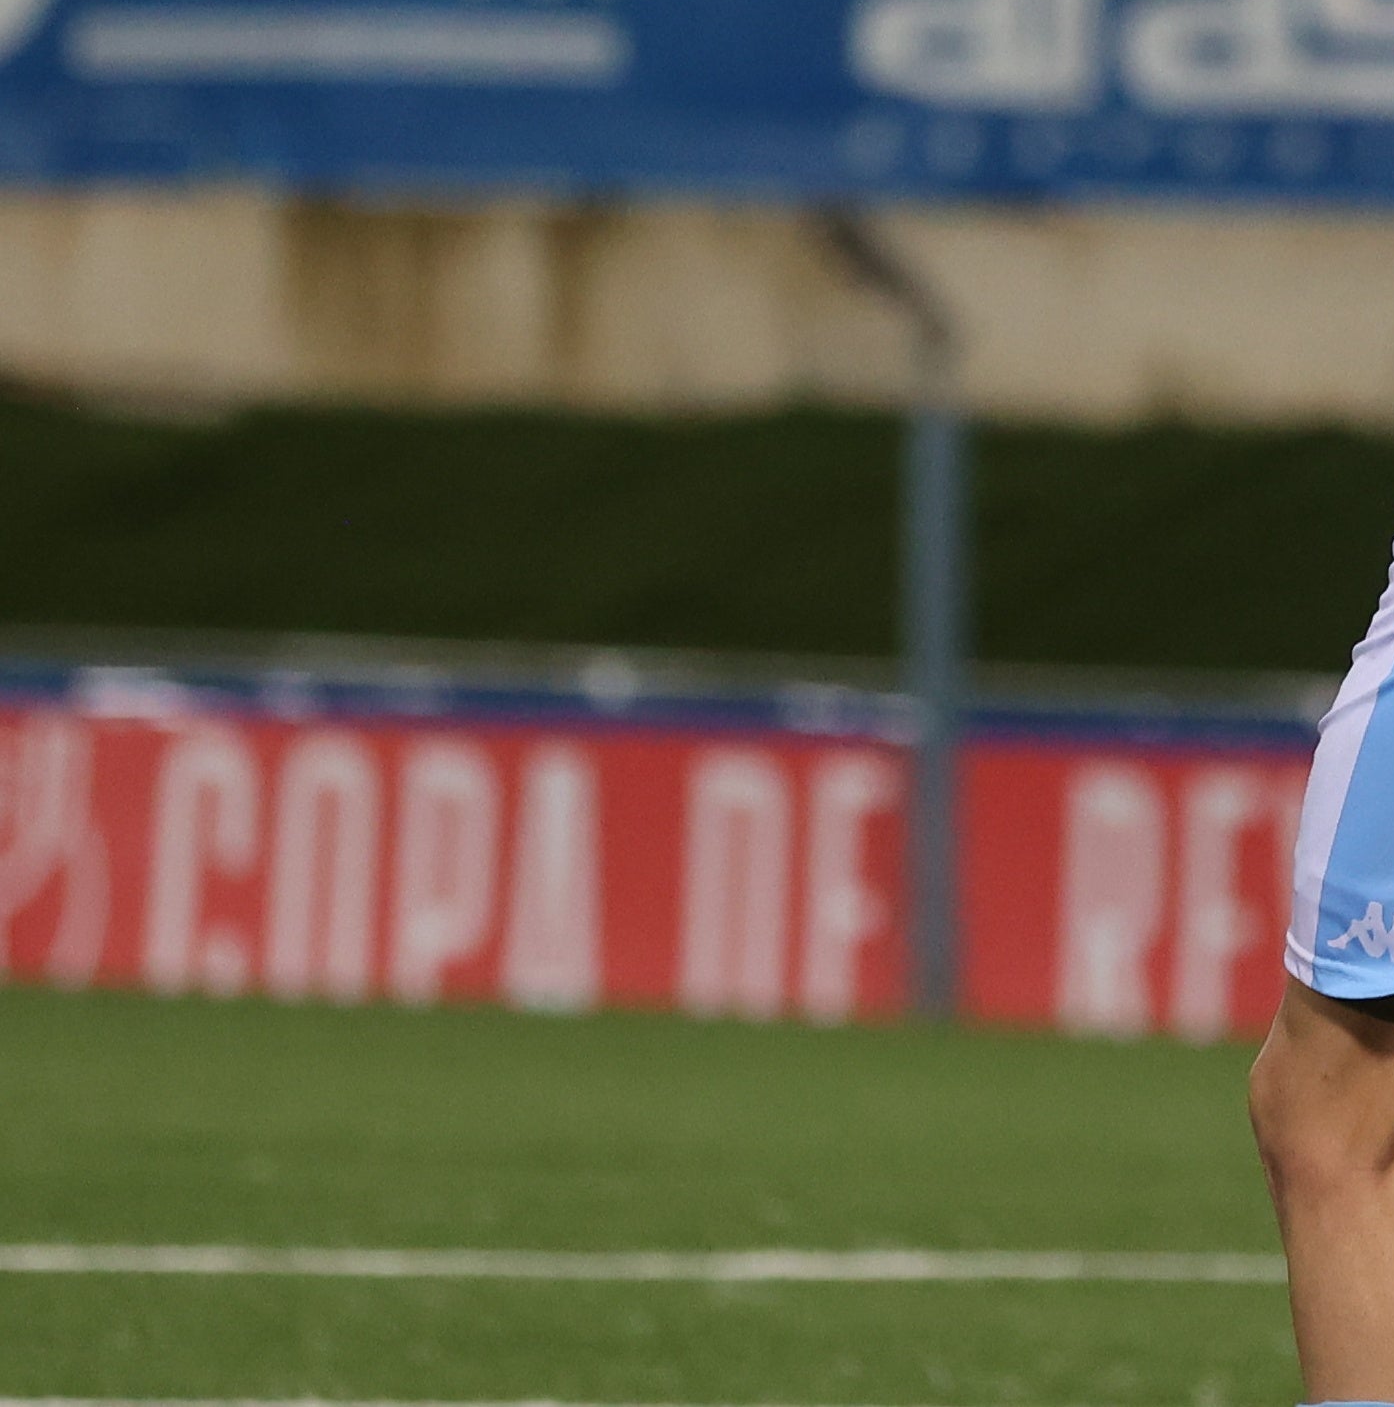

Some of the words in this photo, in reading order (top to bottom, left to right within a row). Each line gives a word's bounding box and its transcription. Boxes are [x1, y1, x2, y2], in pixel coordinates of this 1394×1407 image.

[145, 724, 598, 1009] COPA
[678, 744, 905, 1024] DE
[1056, 759, 1306, 1038] RE
